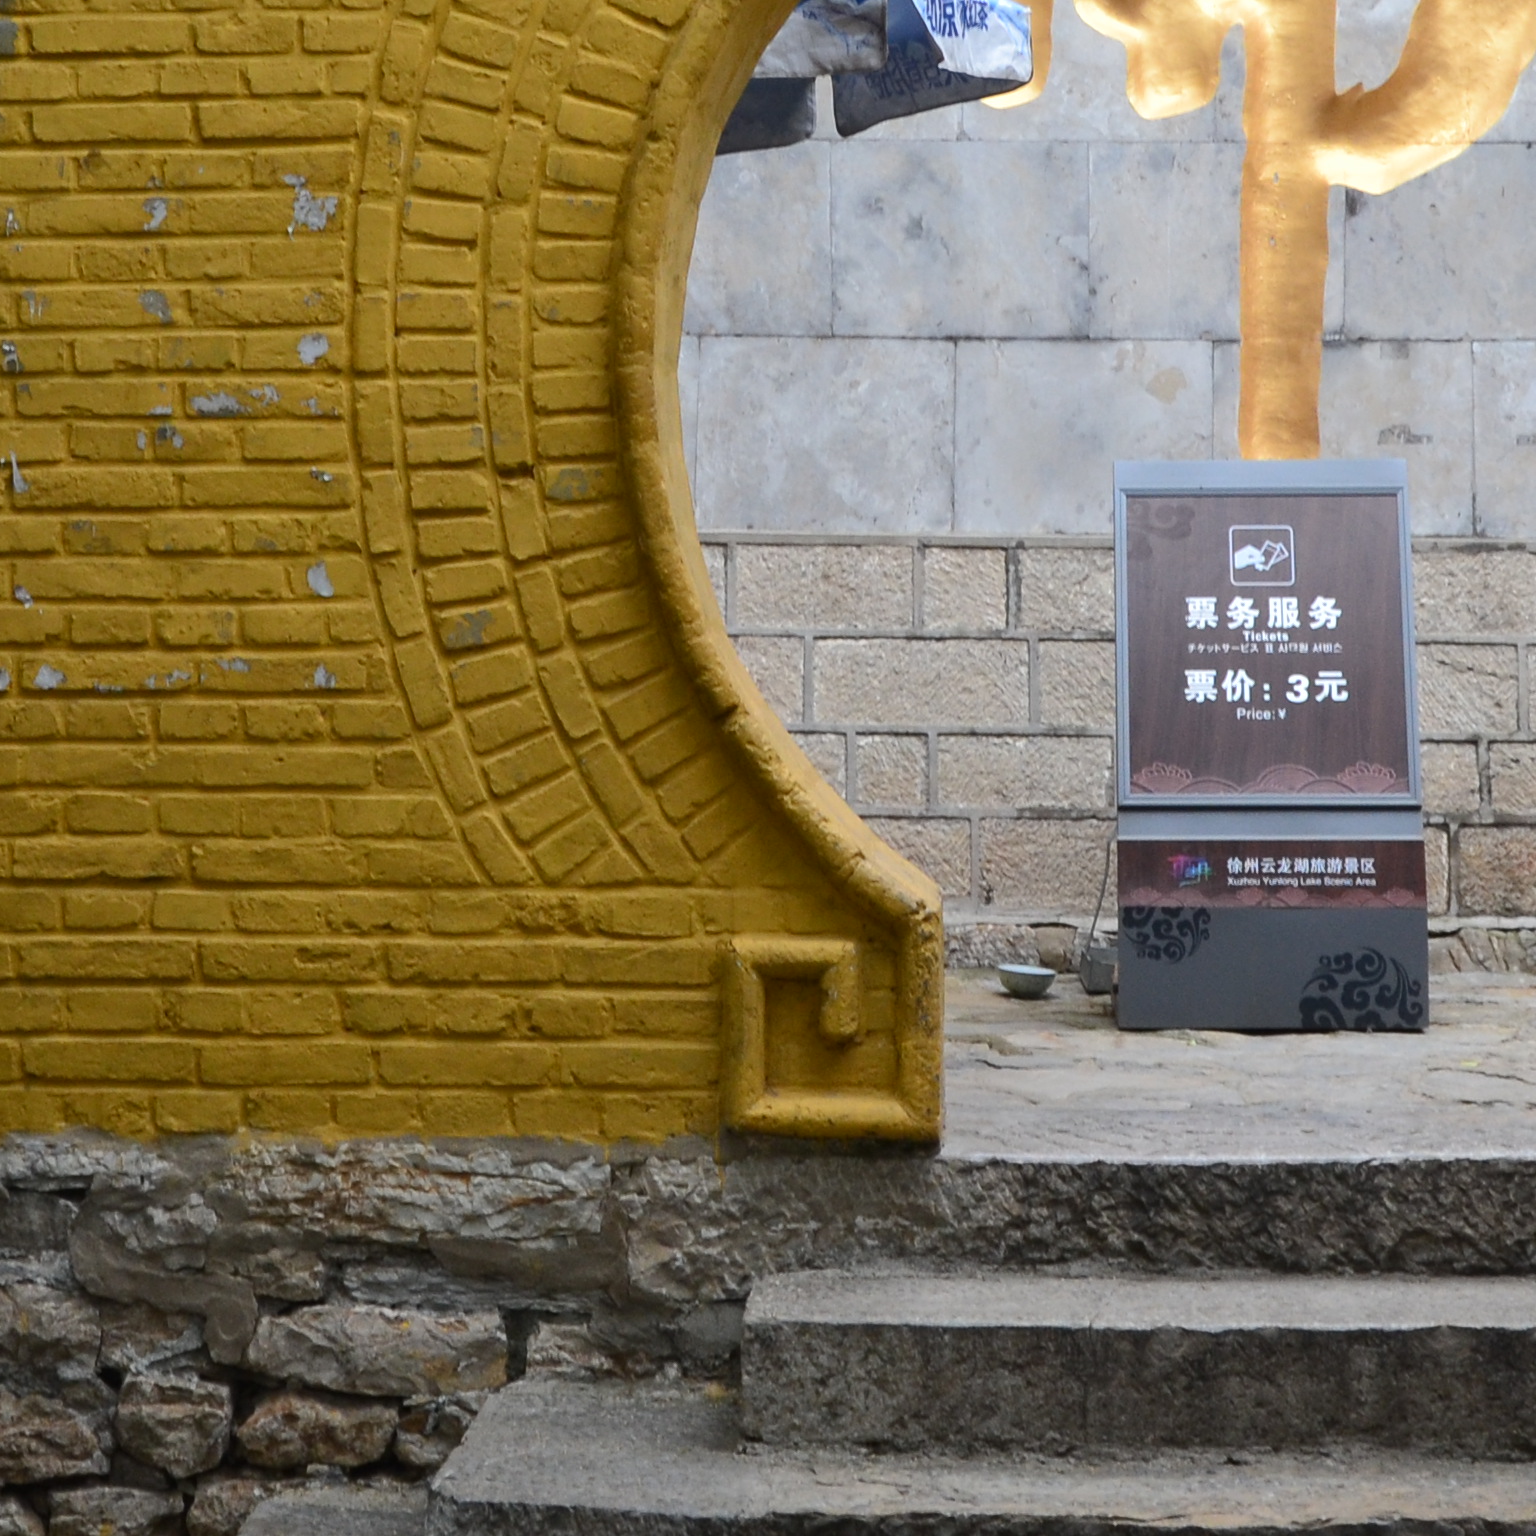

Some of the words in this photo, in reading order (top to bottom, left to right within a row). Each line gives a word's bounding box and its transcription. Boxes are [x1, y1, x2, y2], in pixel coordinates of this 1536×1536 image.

[1185, 595, 1343, 630] 票务服务
[1242, 630, 1290, 642] Tickets
[1227, 856, 1376, 875] 徐州云龙湖旅游景区
[1227, 876, 1261, 886] Xuzhou
[1262, 876, 1299, 888] Yunlong
[1300, 876, 1322, 886] Lake
[1324, 876, 1353, 886] Scenic
[1355, 876, 1377, 886] Area
